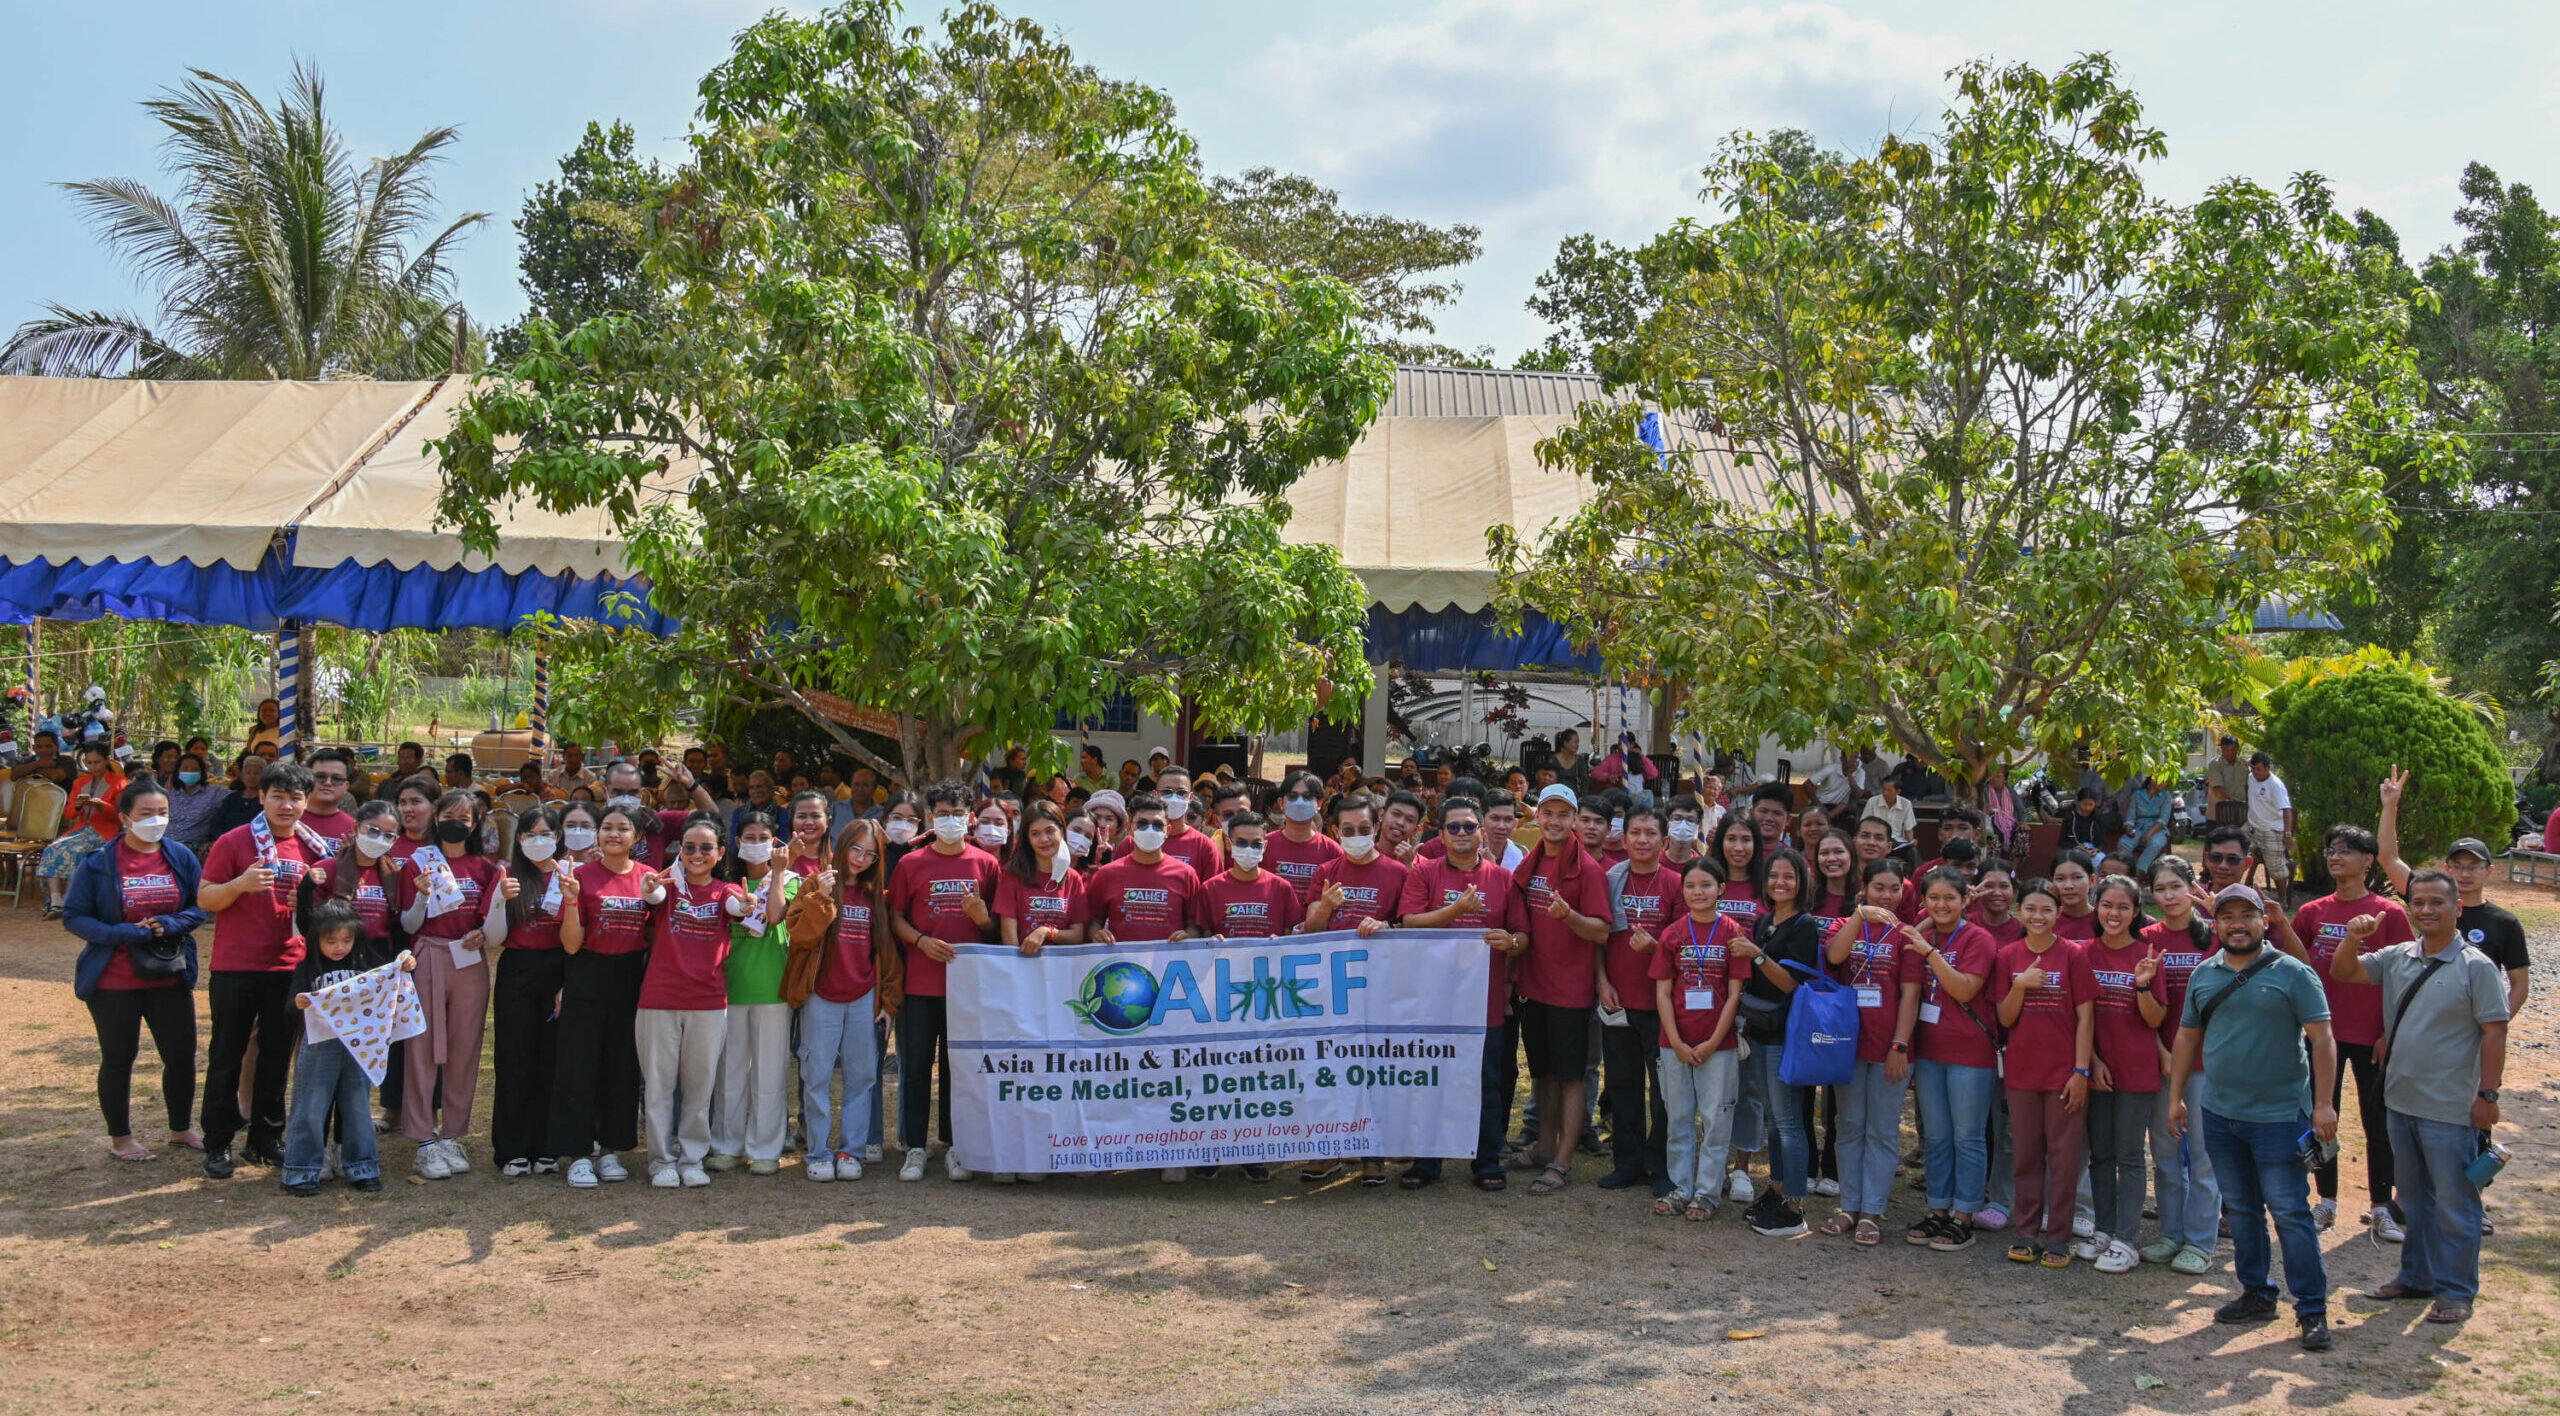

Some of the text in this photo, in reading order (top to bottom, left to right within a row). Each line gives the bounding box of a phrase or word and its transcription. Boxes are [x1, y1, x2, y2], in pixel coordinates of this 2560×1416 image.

[1135, 890, 1168, 902] AHEF
[1724, 902, 1757, 913] AHEF
[1237, 904, 1268, 916] AHEF
[1150, 950, 1368, 1025] AHEF
[2099, 974, 2135, 986] AHEF
[978, 1038, 1457, 1074] Asia Health & Education Foundation
[998, 1064, 1439, 1102] Free Medical, Dental, & Optical
[1169, 1097, 1295, 1123] Services
[1047, 1132, 1089, 1148] “Love
[1095, 1134, 1130, 1149] your
[1135, 1127, 1206, 1146] neighbor
[1210, 1129, 1227, 1140] as
[1233, 1126, 1262, 1142] you
[1267, 1122, 1301, 1137] love
